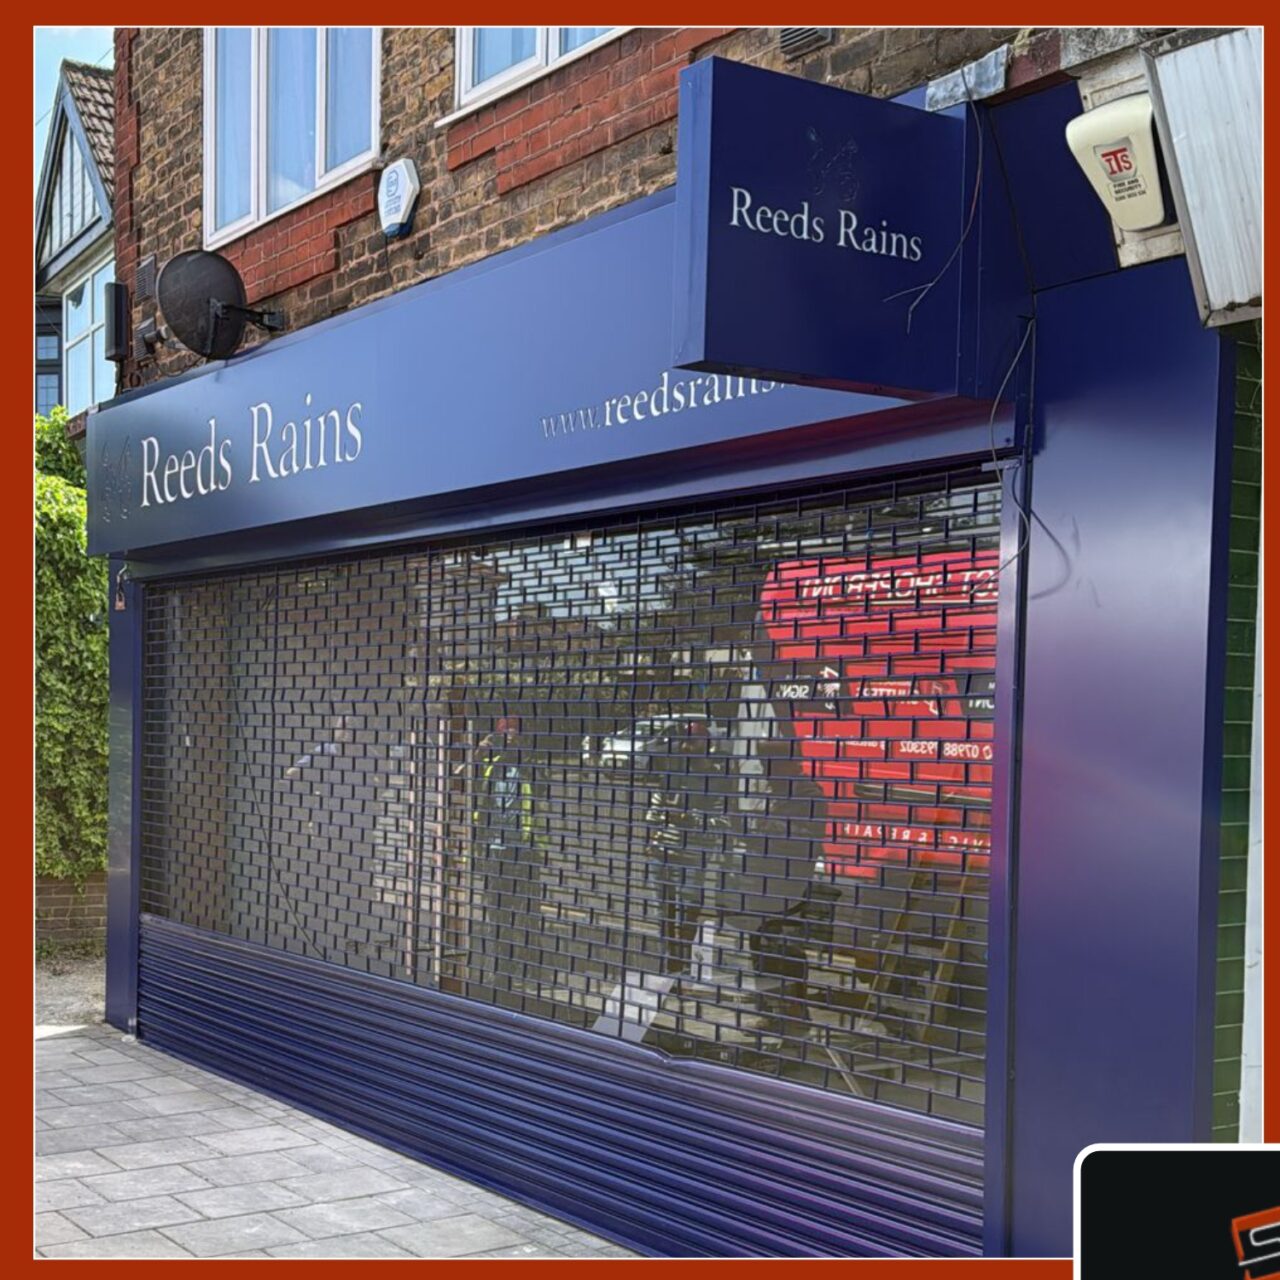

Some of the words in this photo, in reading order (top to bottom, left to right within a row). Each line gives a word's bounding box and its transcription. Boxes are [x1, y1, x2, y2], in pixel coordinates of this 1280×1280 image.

[729, 186, 825, 243] Reeds
[836, 208, 922, 262] Rains
[139, 417, 232, 508] Reeds
[249, 392, 363, 483] Rains
